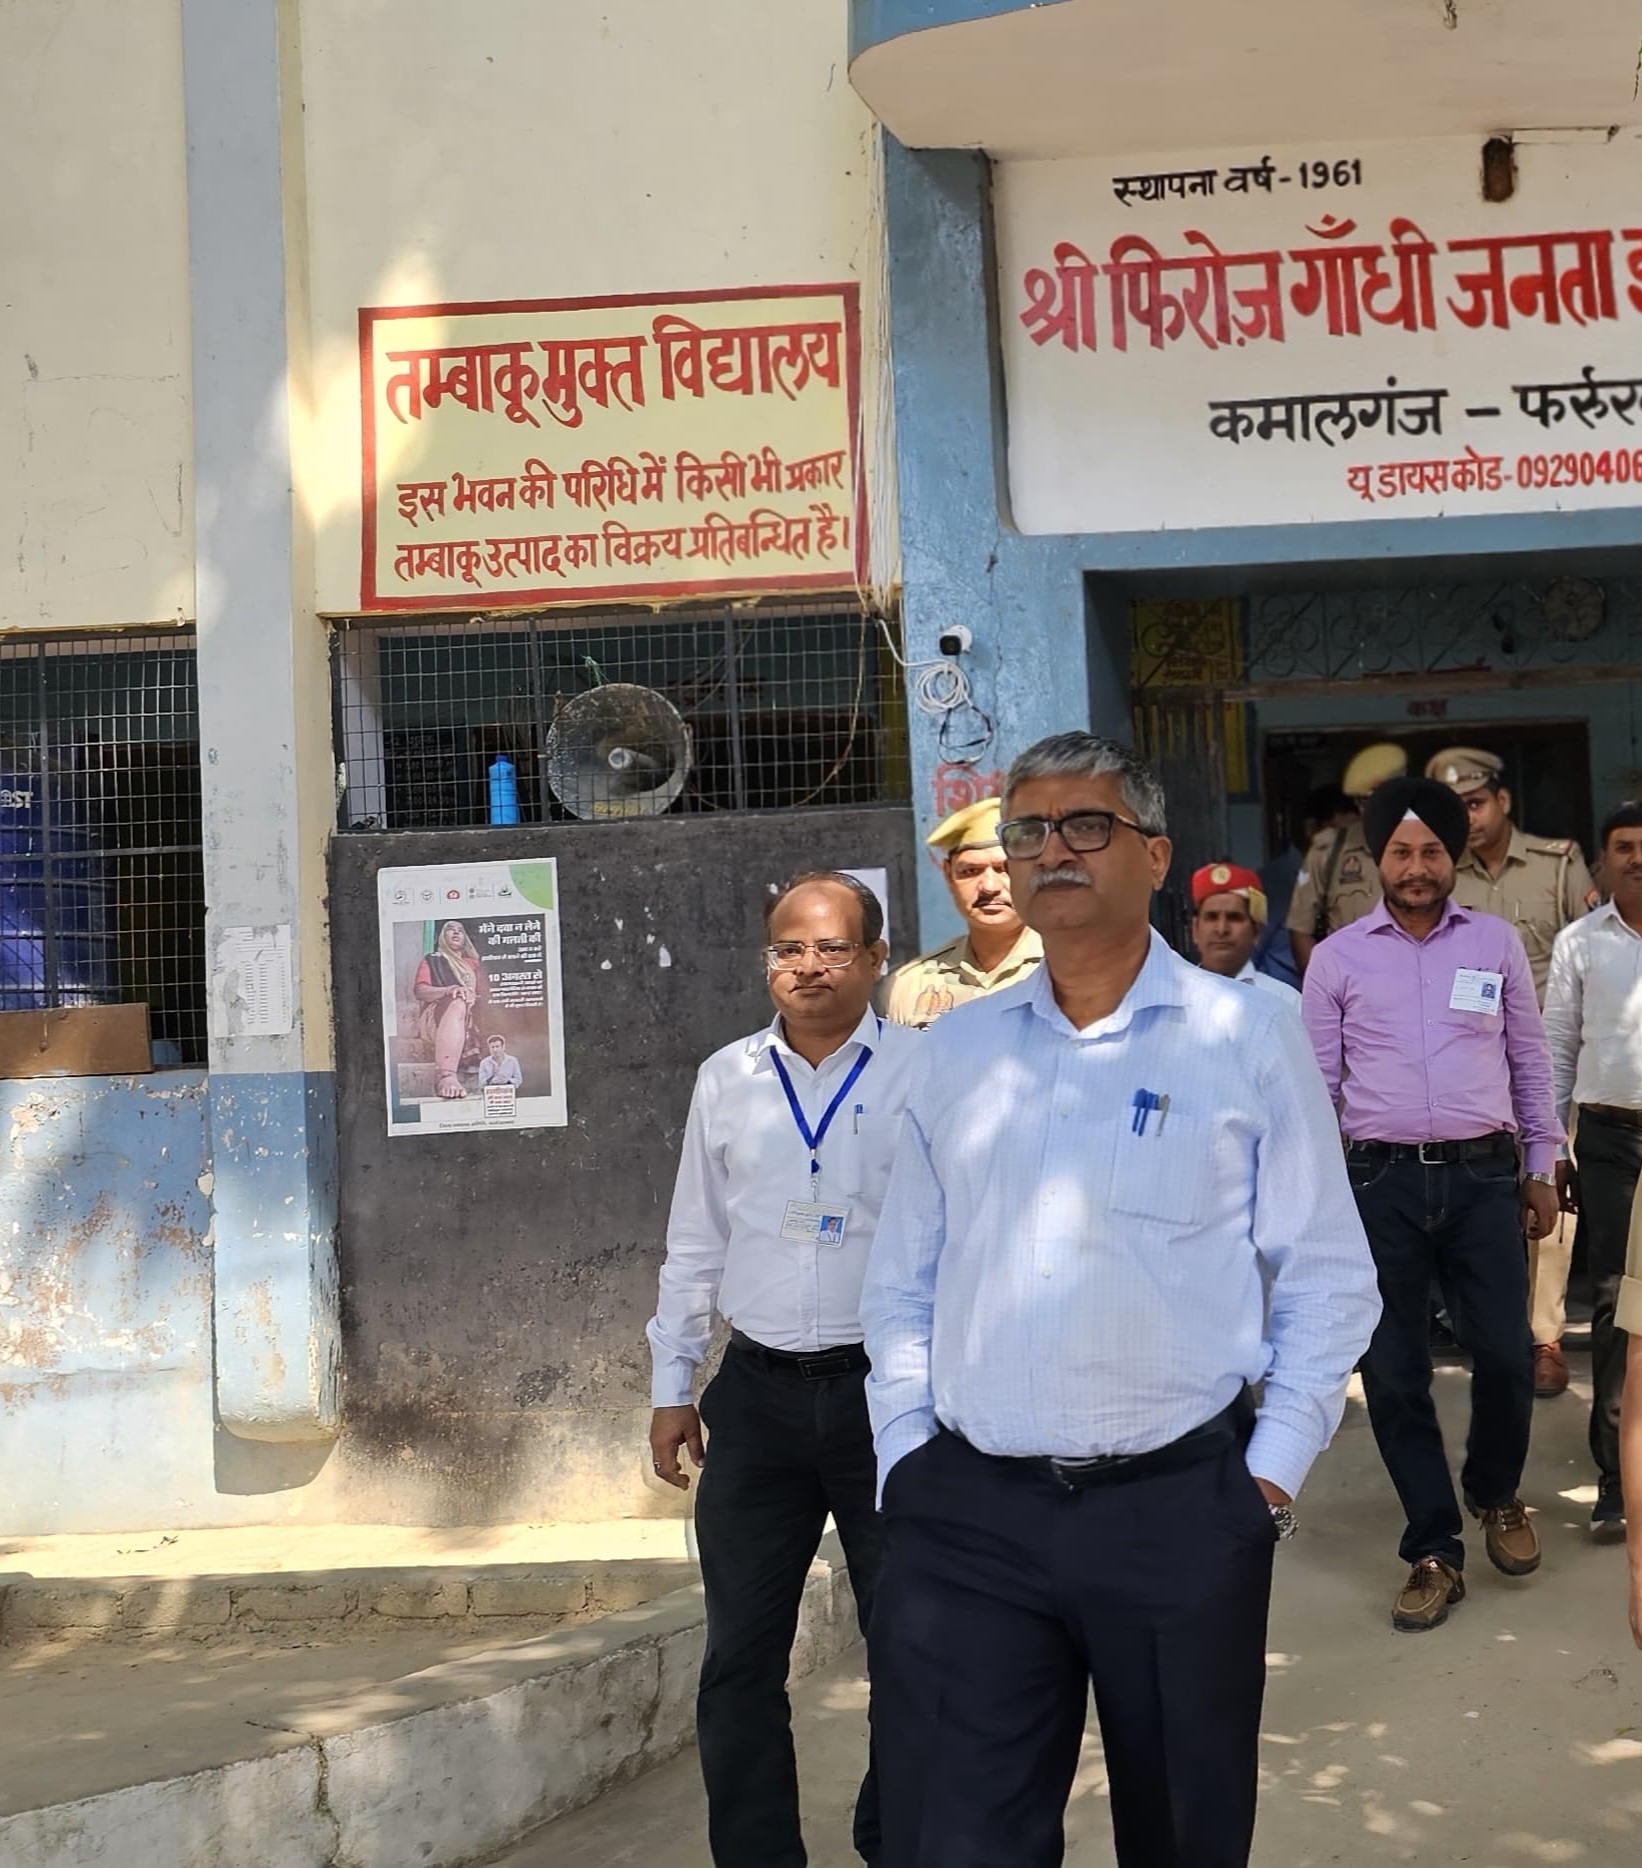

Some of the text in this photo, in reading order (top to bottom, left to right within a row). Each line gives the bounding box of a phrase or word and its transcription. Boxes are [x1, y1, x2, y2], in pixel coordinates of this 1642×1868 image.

[1112, 168, 1217, 206] स्थापना
[1019, 240, 1098, 353] श्री
[1288, 214, 1437, 337] गाँधी
[1446, 230, 1618, 330] जनता
[385, 314, 842, 429] तम्बाकू मुक्त विद्यालय
[1207, 376, 1450, 446] कमालगंज
[396, 445, 847, 528] इस भवन की परिधि में किसी भी प्रकार
[1377, 460, 1451, 499] डायस
[394, 540, 482, 588] तम्बाकू
[482, 534, 567, 578] उत्पाद
[563, 533, 599, 569] का
[601, 520, 687, 568] विक्रय
[686, 508, 812, 566] प्रतिबन्धित
